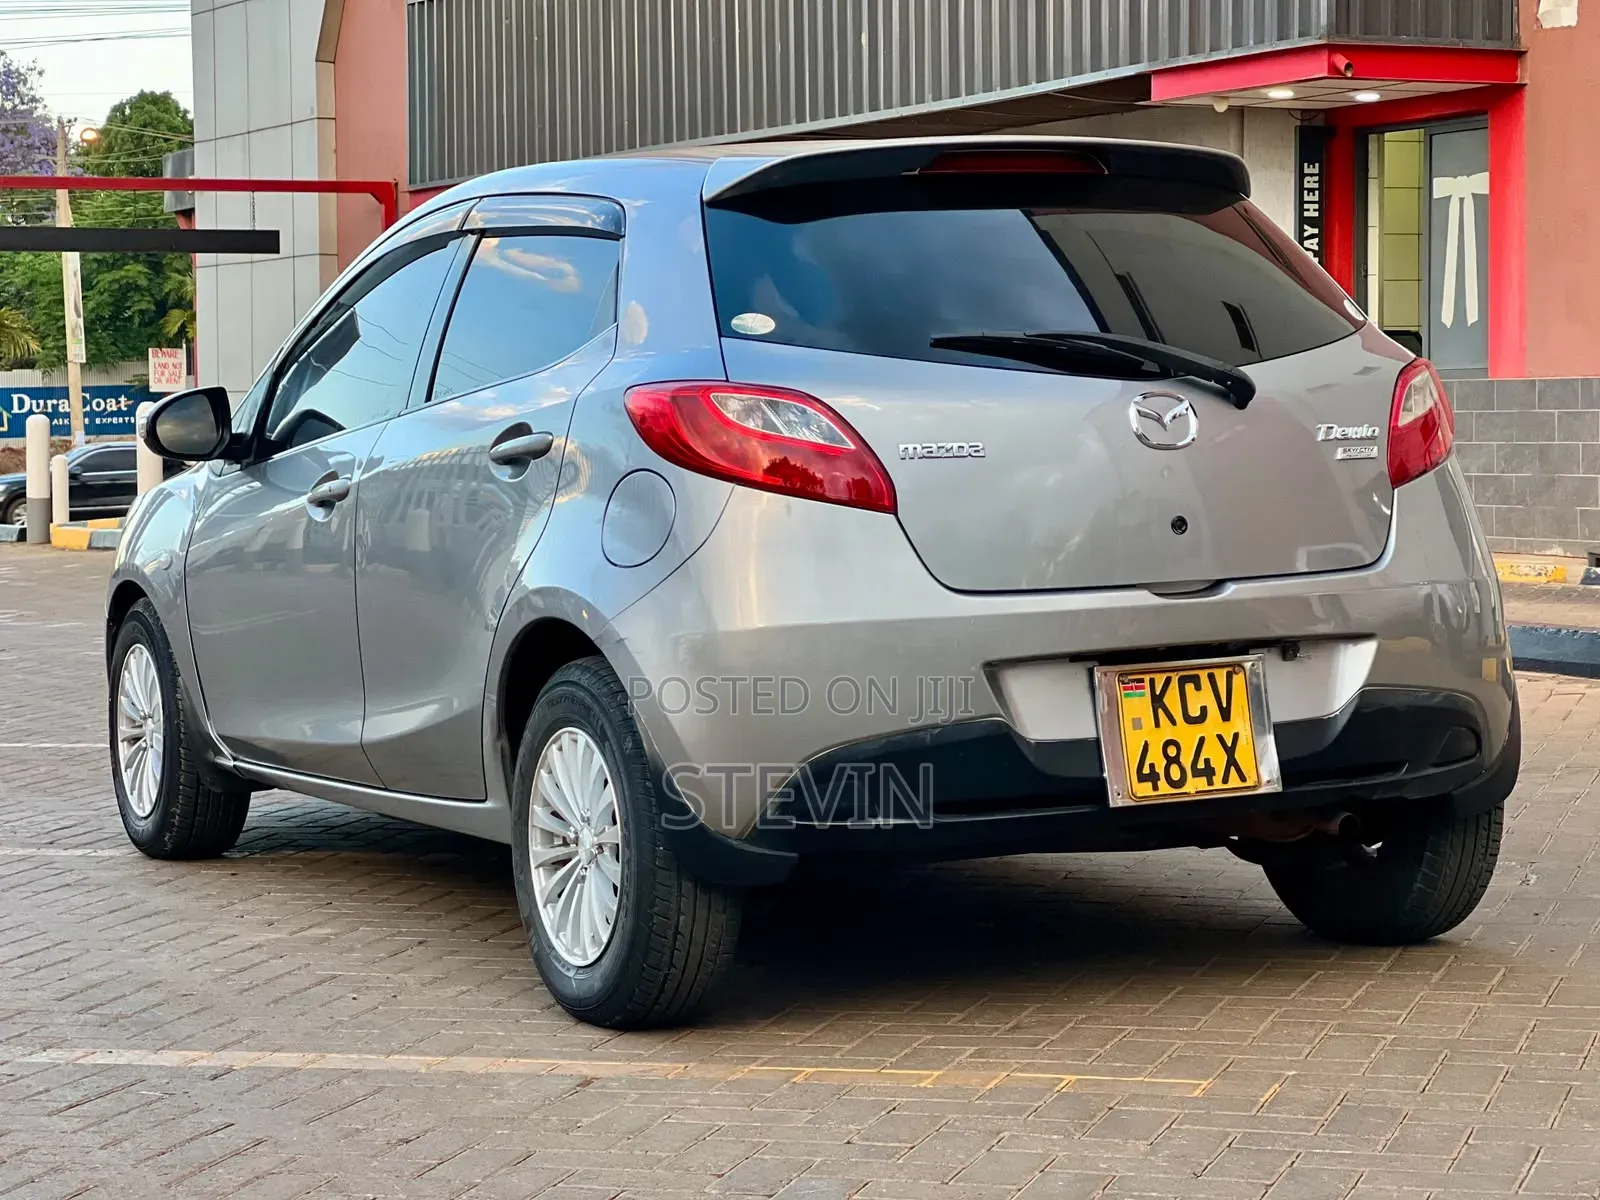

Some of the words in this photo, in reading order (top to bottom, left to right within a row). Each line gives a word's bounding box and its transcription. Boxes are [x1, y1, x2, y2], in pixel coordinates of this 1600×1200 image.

[1304, 162, 1319, 217] HERE
[151, 349, 179, 358] BEWARE
[1149, 670, 1234, 728] KCV
[1136, 732, 1247, 792] 484X
